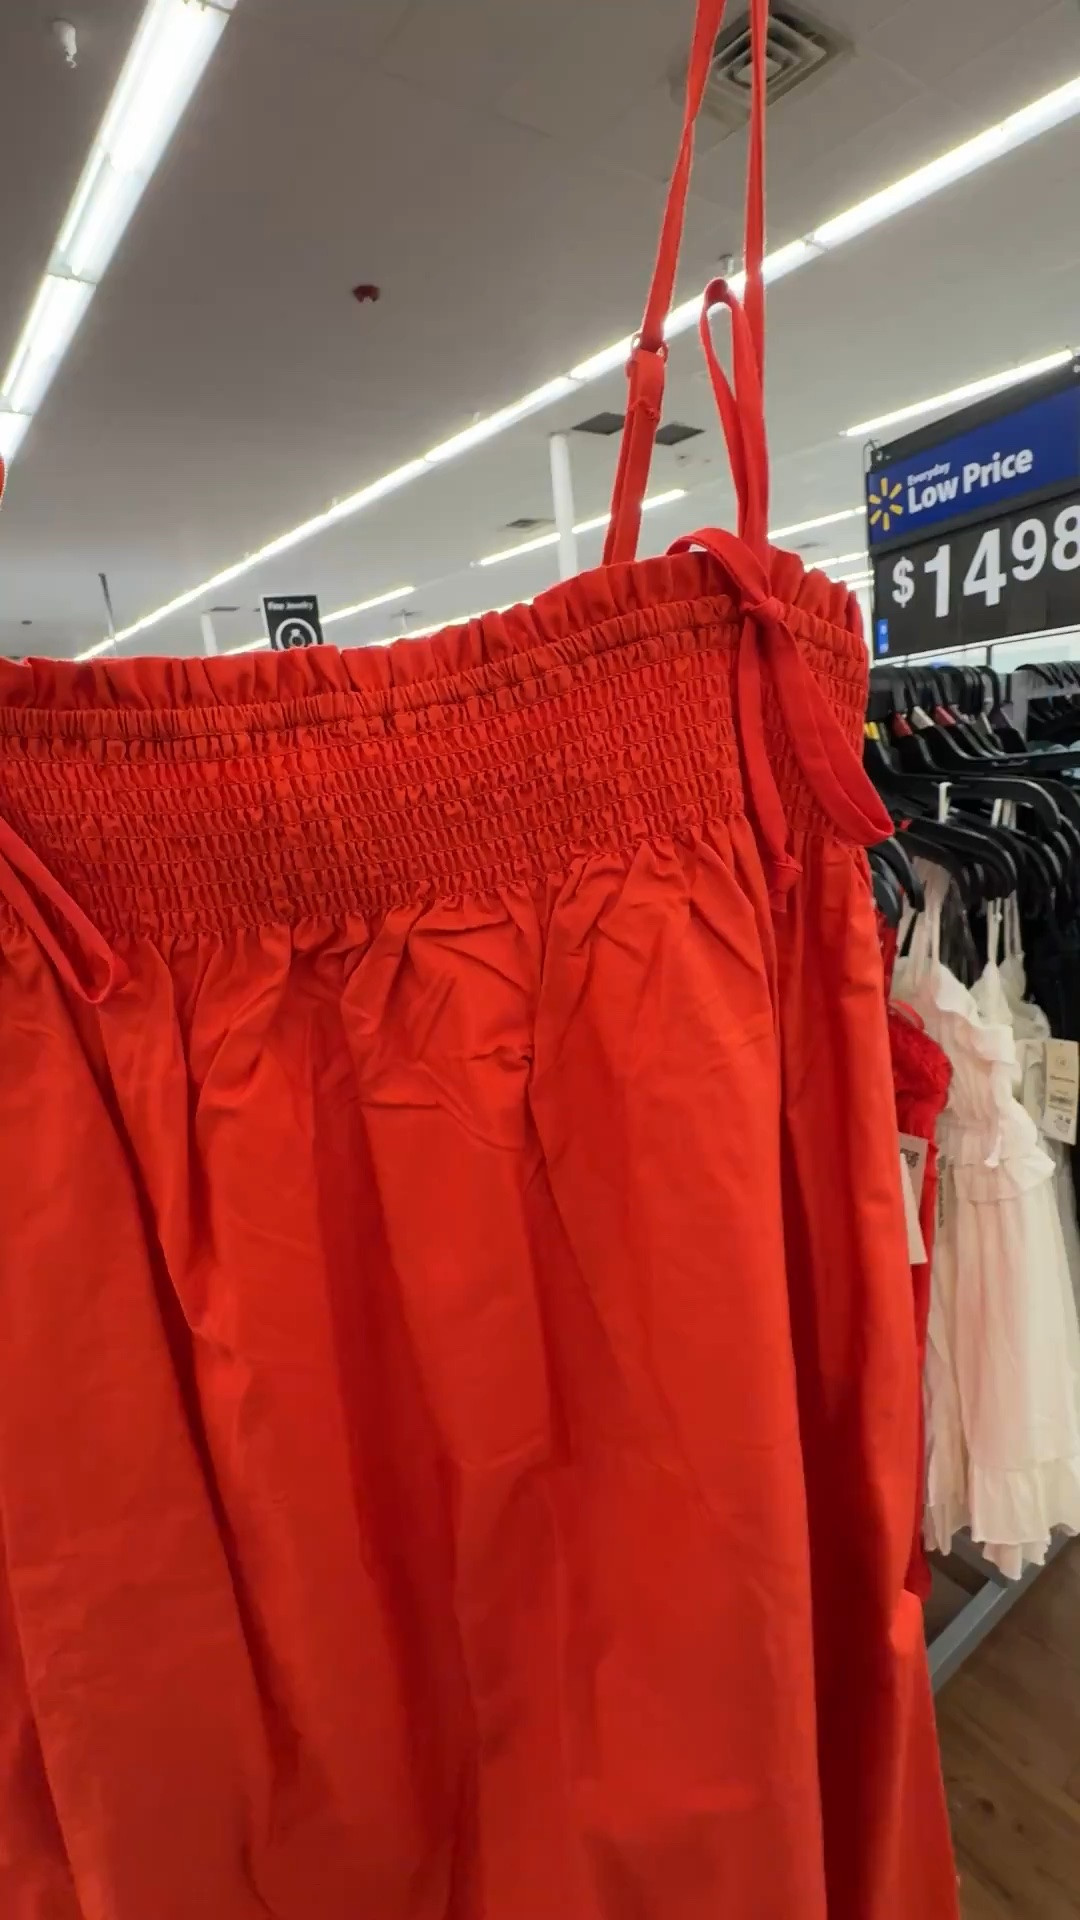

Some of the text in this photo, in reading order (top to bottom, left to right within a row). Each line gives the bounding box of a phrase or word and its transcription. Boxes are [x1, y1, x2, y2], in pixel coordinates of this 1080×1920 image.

[907, 462, 951, 486] Everyday
[908, 449, 1033, 514] Low Price
